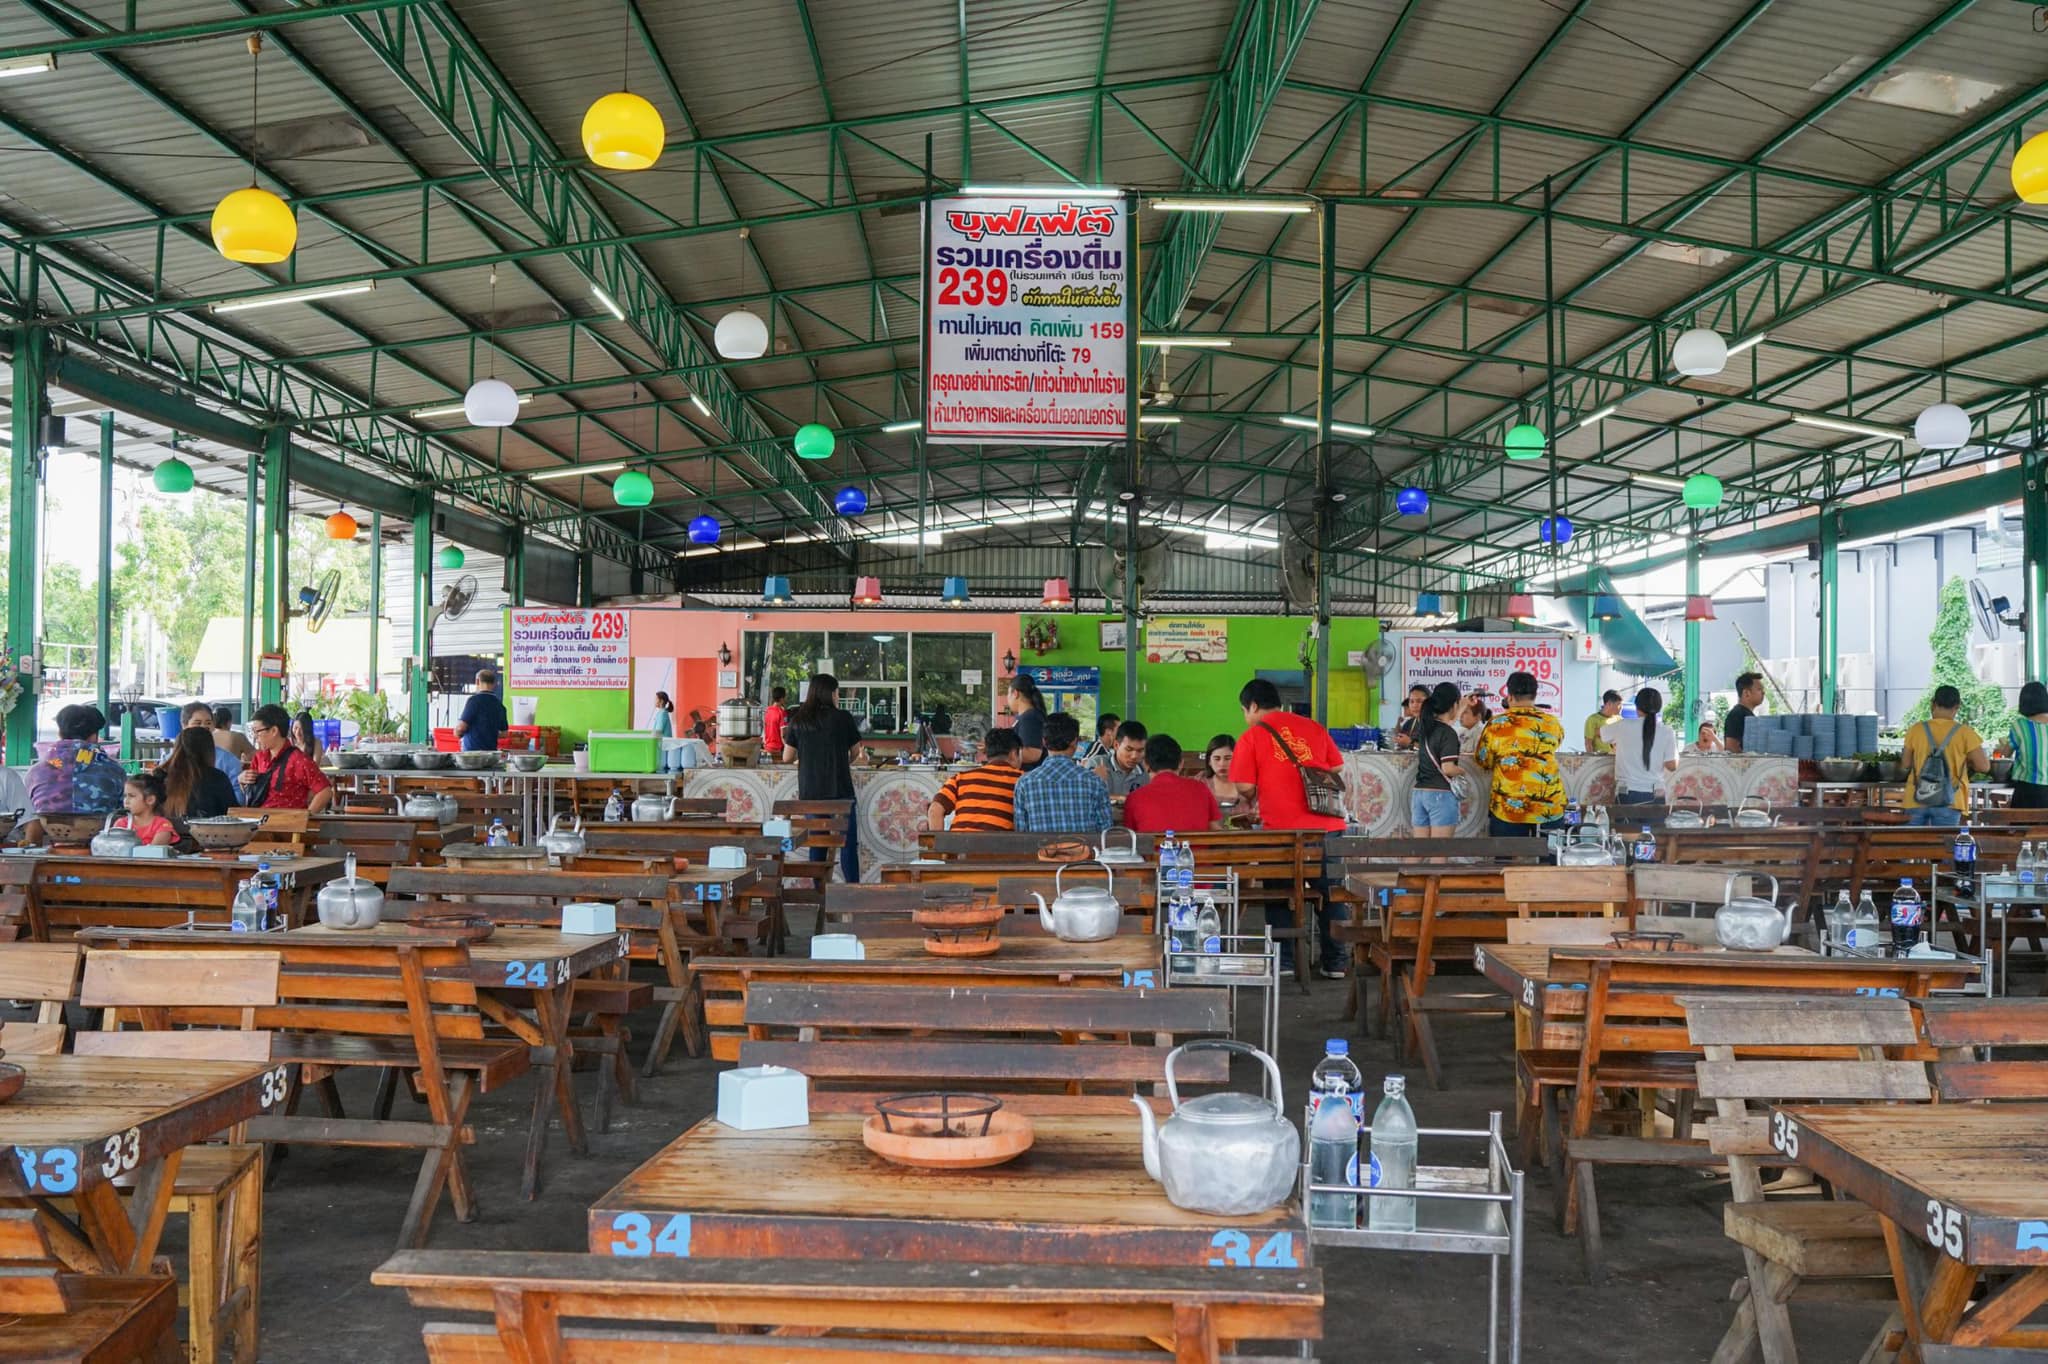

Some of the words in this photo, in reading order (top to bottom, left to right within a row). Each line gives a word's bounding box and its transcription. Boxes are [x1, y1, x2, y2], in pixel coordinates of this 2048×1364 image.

[937, 239, 1121, 269] รวมเครื่องดื่ม
[938, 267, 1008, 306] 239
[939, 314, 1021, 336] ทานไม่หมด
[1030, 314, 1083, 338] คิดเพิ่ม
[1090, 322, 1124, 339] 159
[964, 340, 1066, 363] เพิ่มเตาย่างที่โต๊ะ
[1072, 347, 1091, 363] 79
[591, 612, 624, 639] 239
[1487, 669, 1506, 677] 159
[1514, 659, 1551, 680] 239
[694, 883, 722, 902] 15
[618, 932, 630, 957] 24
[505, 960, 548, 987] 24
[557, 957, 570, 985] 24
[1124, 970, 1154, 989] 5
[1523, 978, 1534, 1006] 26
[261, 1064, 287, 1108] 33
[1774, 1111, 1798, 1160] 35
[102, 1126, 140, 1178] 33
[611, 1212, 691, 1257] 34
[1926, 1200, 1963, 1259] 35
[1208, 1229, 1298, 1268] 34
